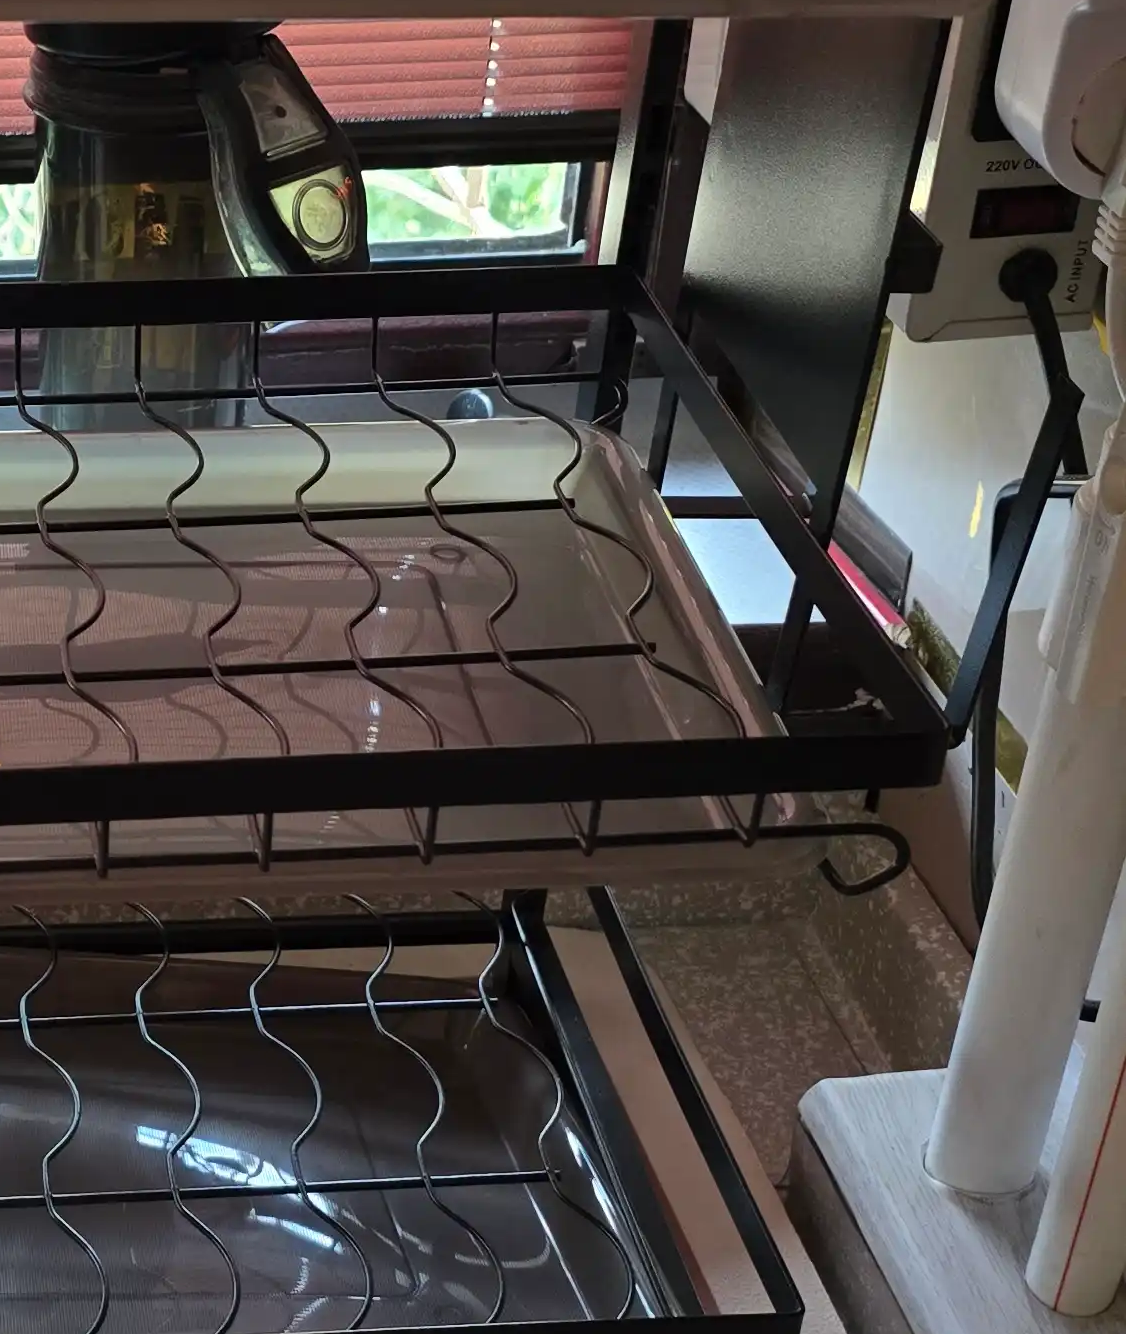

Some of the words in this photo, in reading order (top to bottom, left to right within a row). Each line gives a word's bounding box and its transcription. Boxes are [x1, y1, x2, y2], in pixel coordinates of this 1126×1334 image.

[986, 160, 1021, 173] 220V
[1069, 240, 1088, 280] INPUT
[1063, 283, 1079, 303] AC
